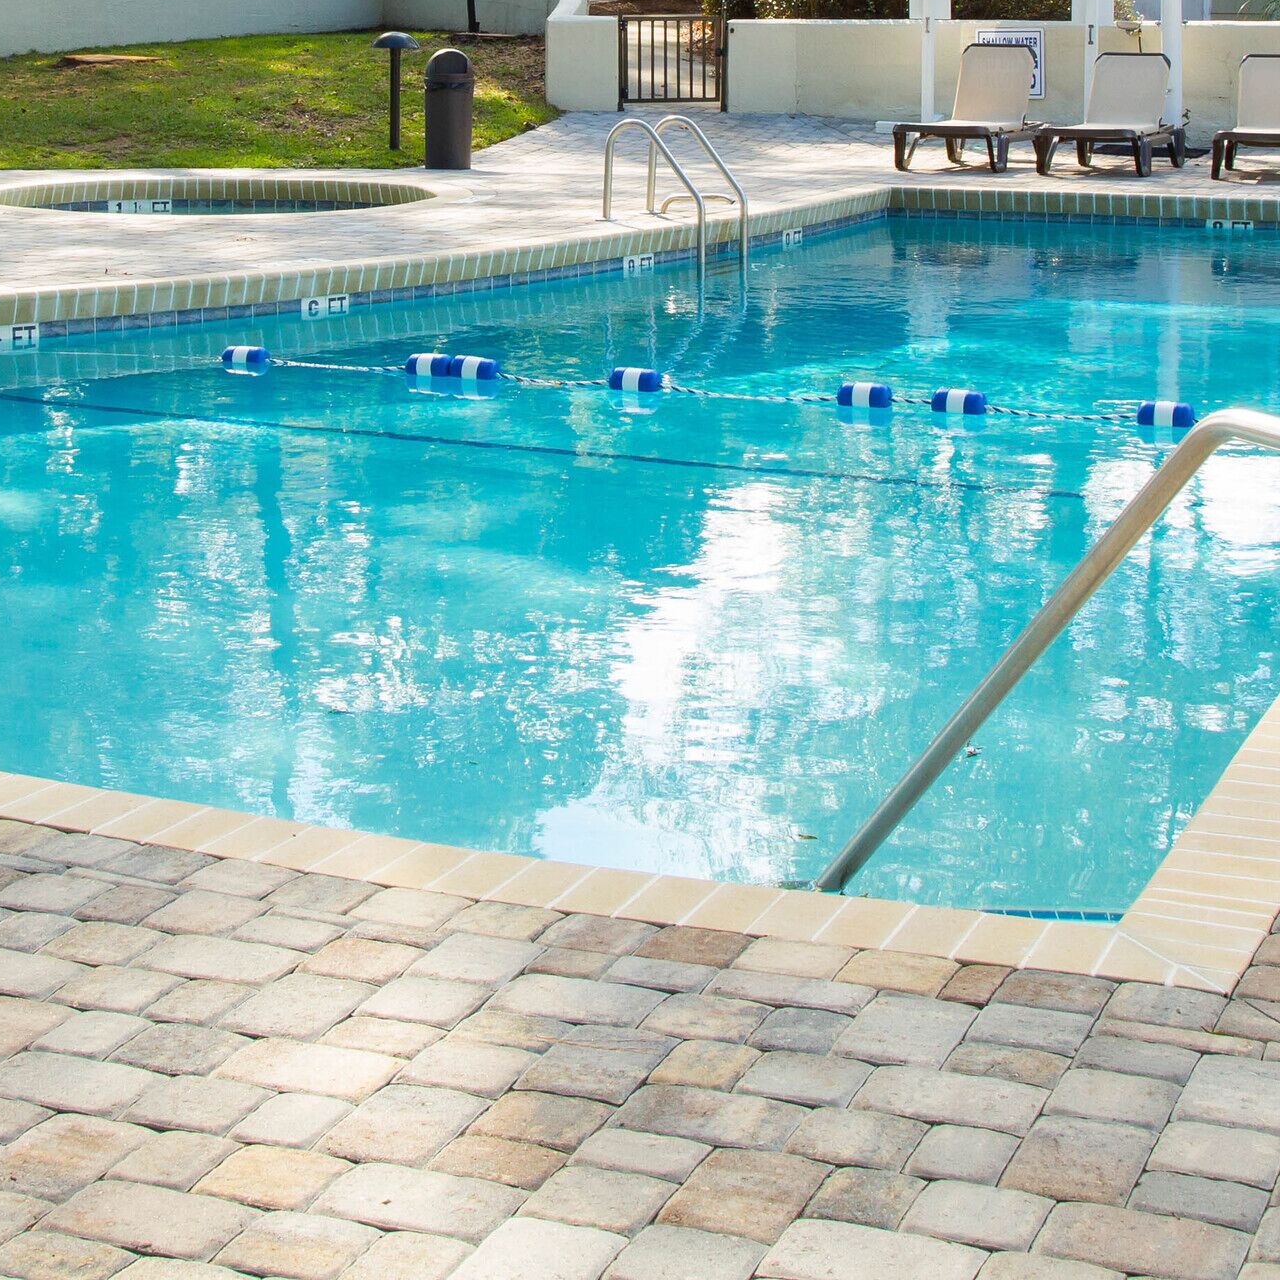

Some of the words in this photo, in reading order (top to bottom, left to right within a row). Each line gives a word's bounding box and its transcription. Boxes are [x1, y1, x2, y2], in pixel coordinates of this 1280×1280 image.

[982, 37, 1013, 45] SHALLOW
[1015, 37, 1037, 47] WATER
[12, 325, 37, 340] FT
